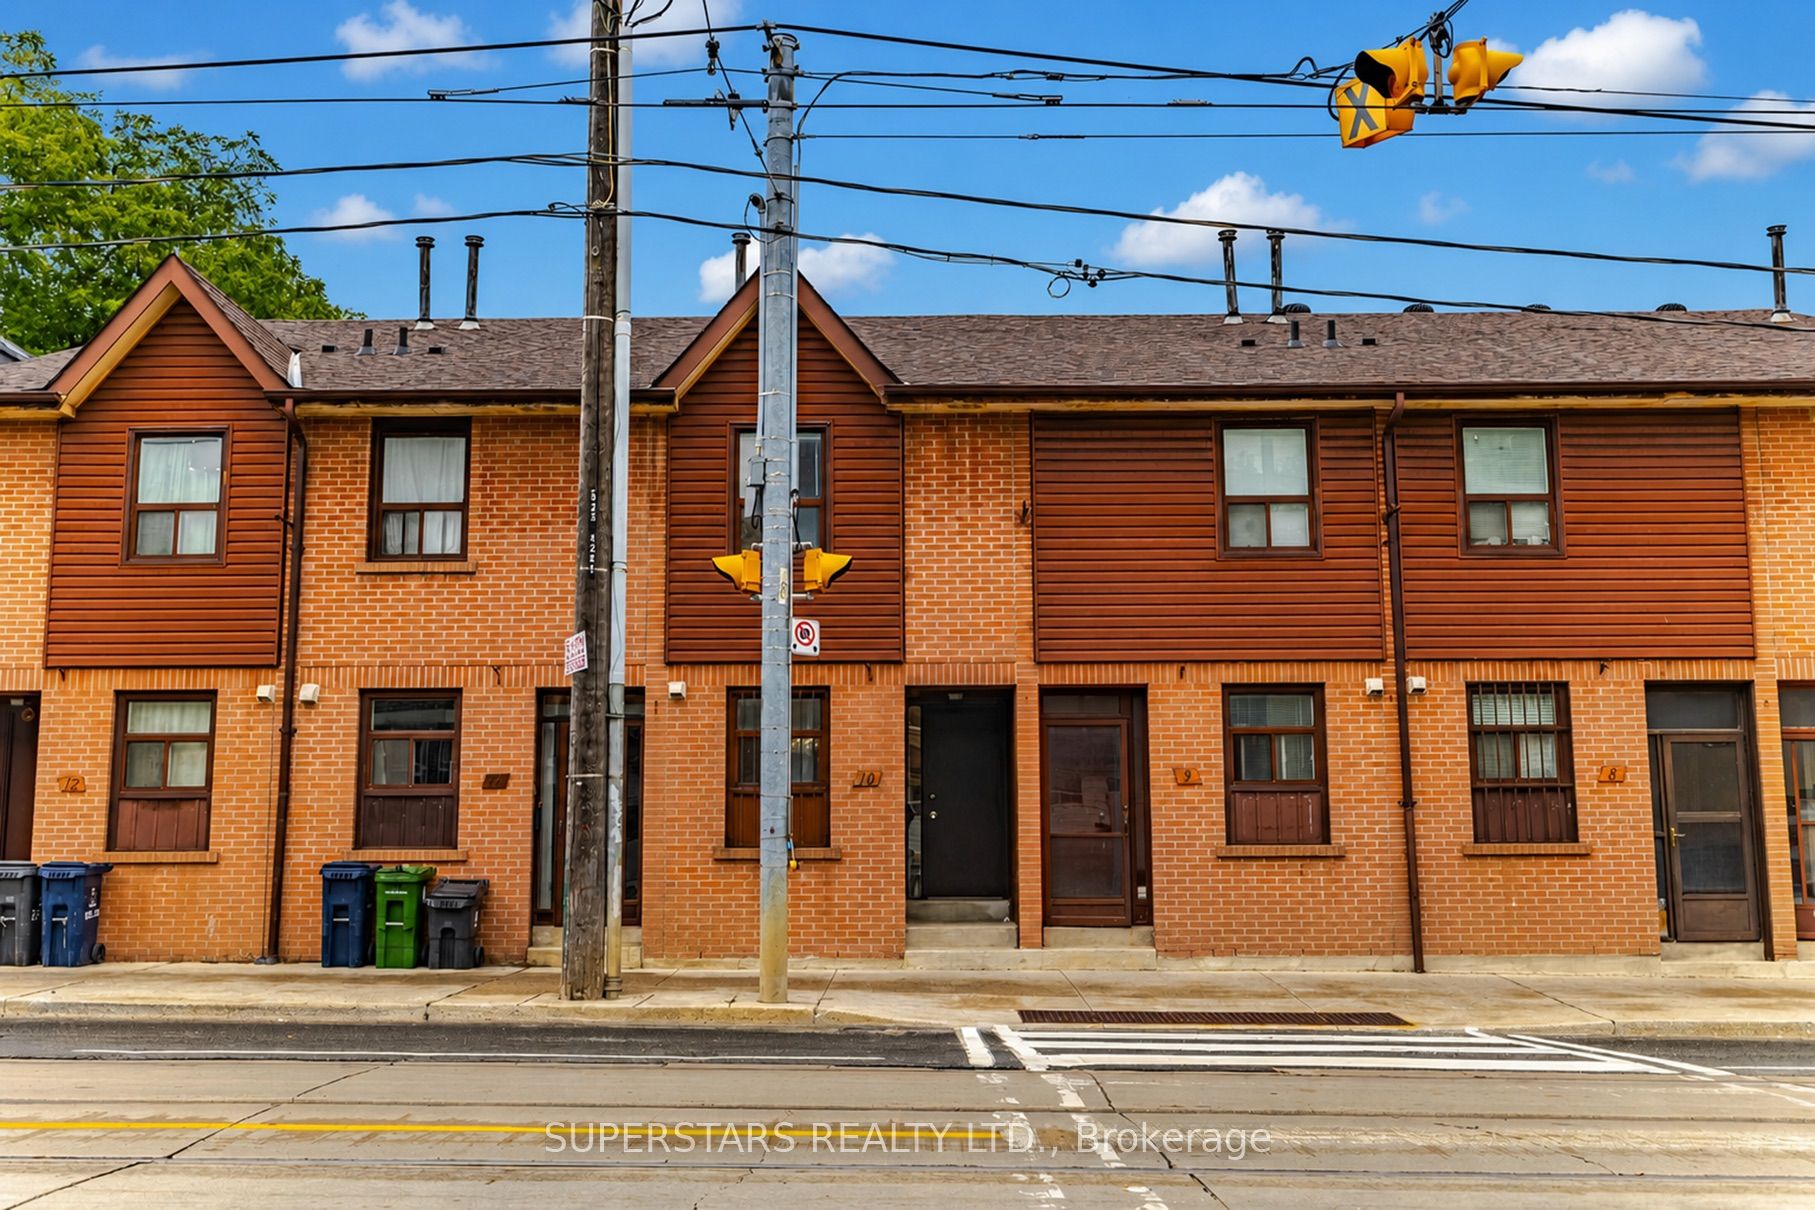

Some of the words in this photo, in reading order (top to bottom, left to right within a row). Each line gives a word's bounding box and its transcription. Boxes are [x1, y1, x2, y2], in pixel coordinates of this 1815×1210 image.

[859, 772, 875, 785] 10
[1184, 769, 1192, 782] 9
[1609, 768, 1617, 780] 8
[64, 777, 80, 791] 12
